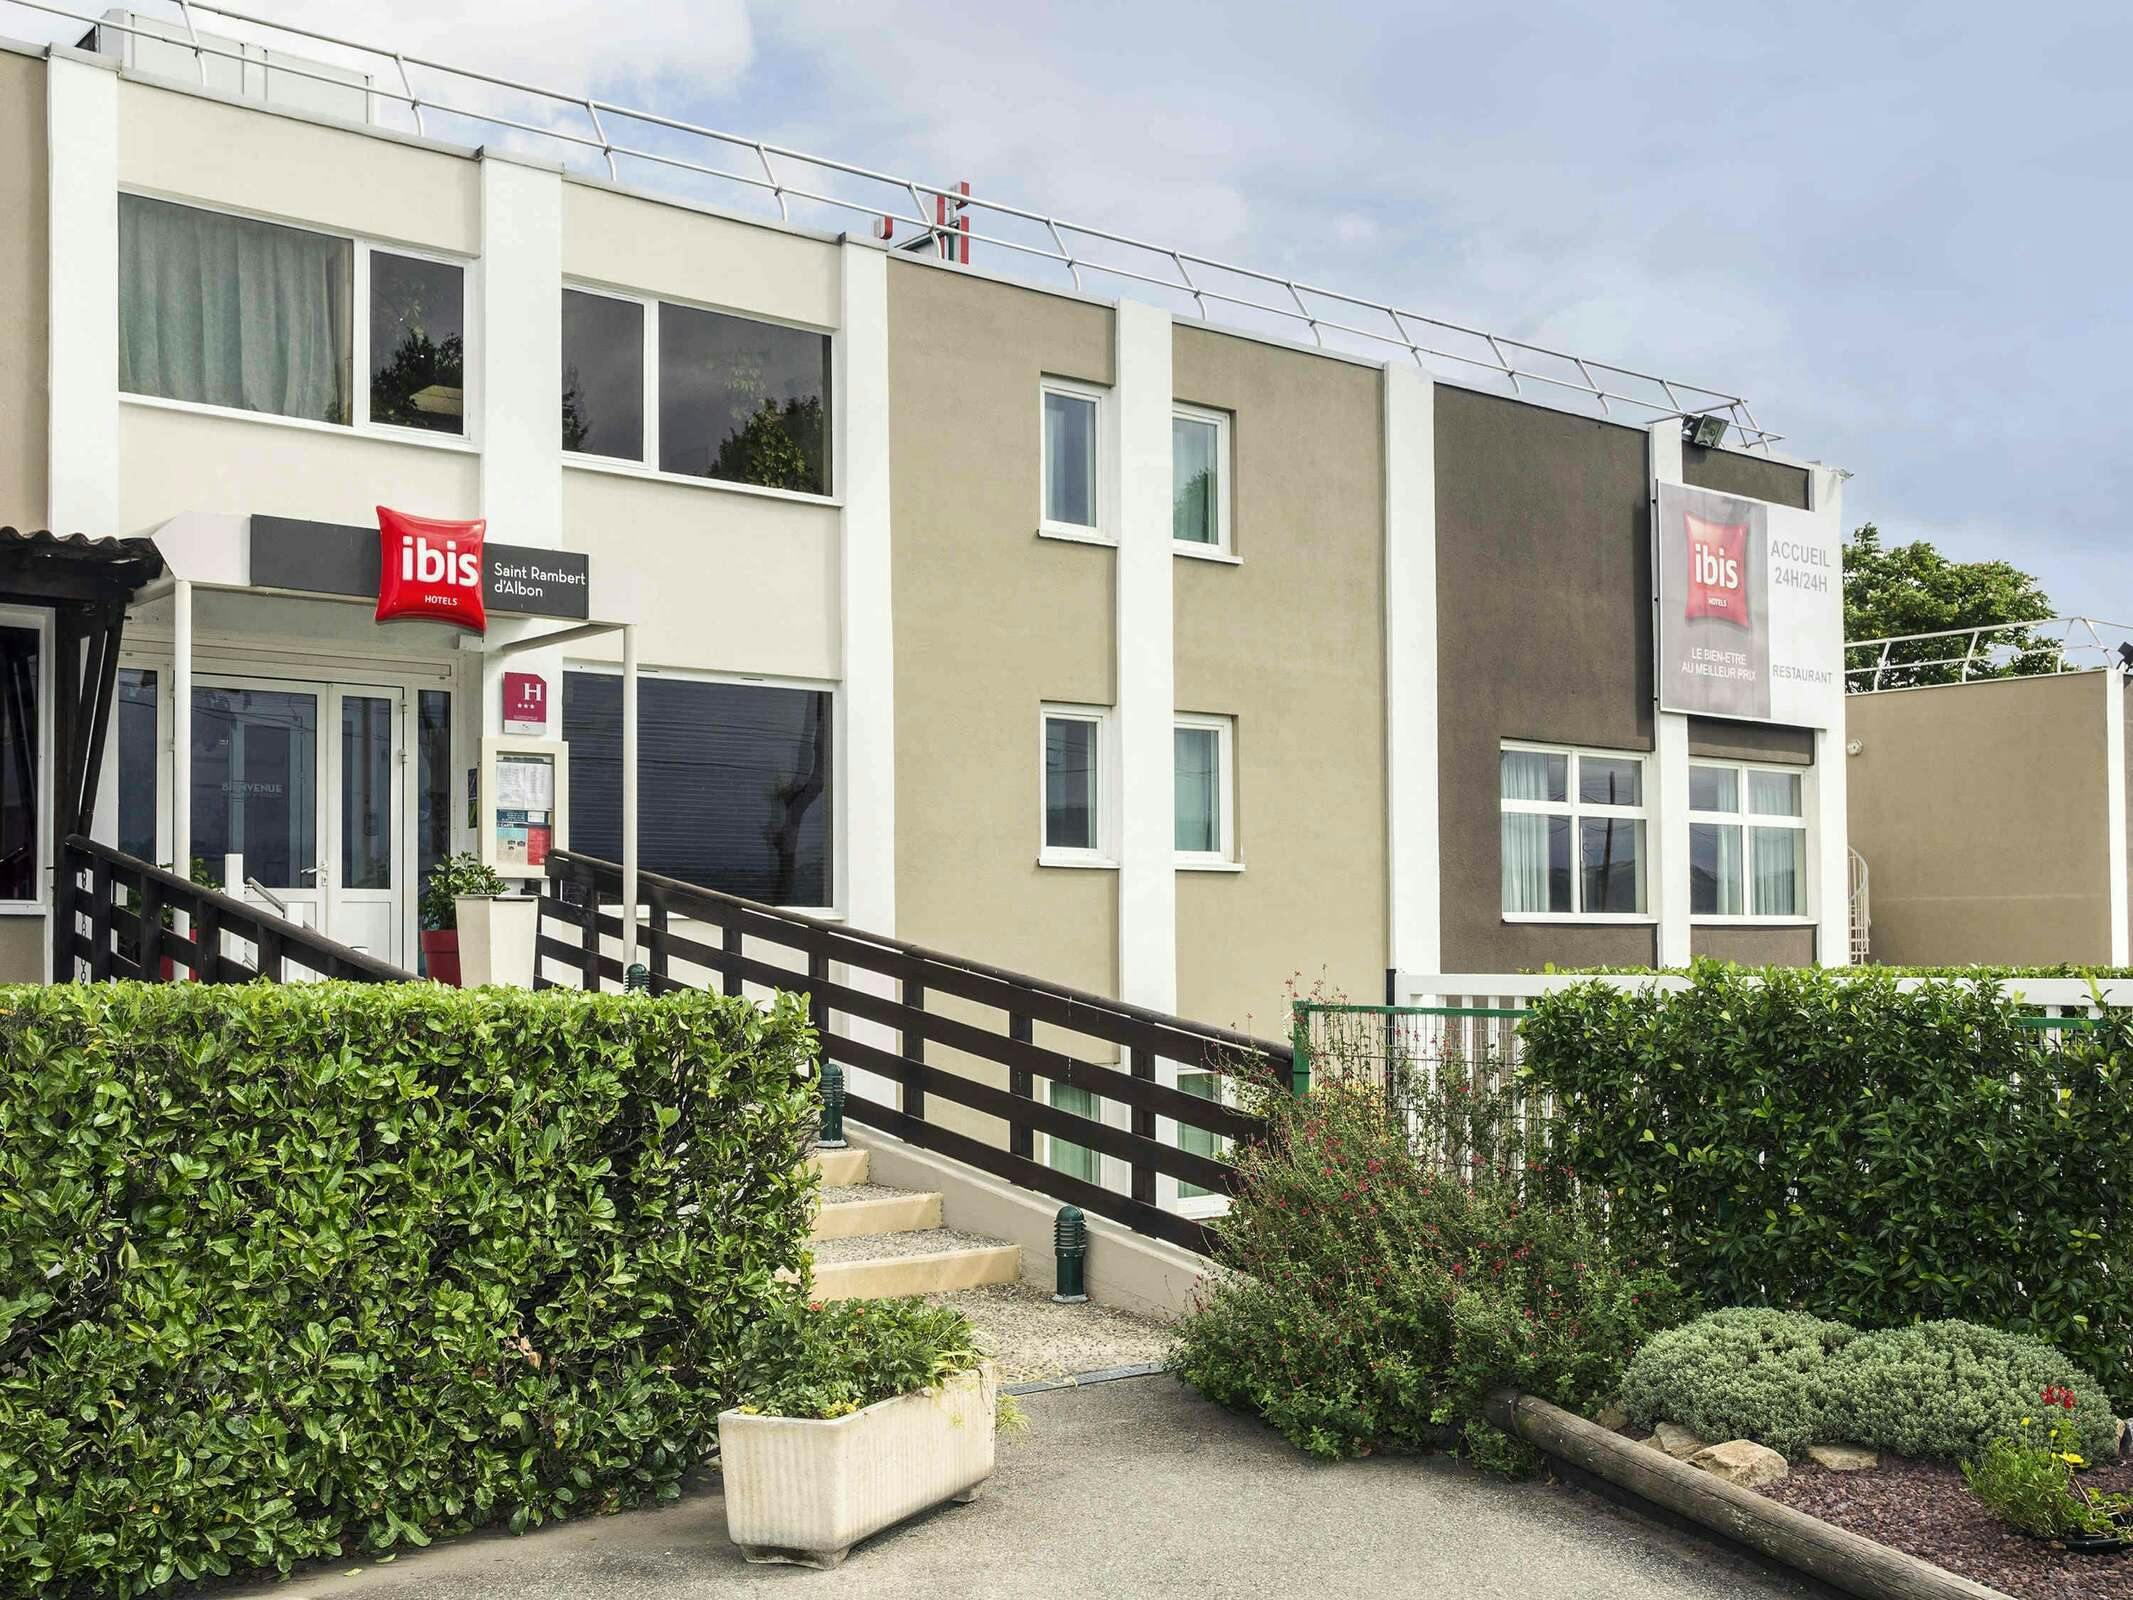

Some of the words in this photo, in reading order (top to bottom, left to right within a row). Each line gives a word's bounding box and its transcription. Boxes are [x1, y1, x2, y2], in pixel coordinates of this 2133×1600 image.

[402, 535, 479, 587] ibis
[1770, 540, 1831, 567] ACCUEIL
[494, 562, 527, 579] Saint
[531, 566, 585, 585] Rambert
[1695, 543, 1738, 589] ibis
[494, 579, 543, 597] d'Albon
[1775, 566, 1827, 593] 24H/24H
[424, 594, 458, 606] HOTELS
[1708, 597, 1727, 607] HOTELS
[1691, 647, 1703, 660] LE
[1681, 661, 1694, 673] AU
[1695, 663, 1736, 679] MEILLEUR
[1737, 668, 1758, 681] PRIX
[1772, 664, 1833, 686] RESTAURANT
[524, 683, 542, 701] H
[222, 783, 283, 793] BINVENUE
